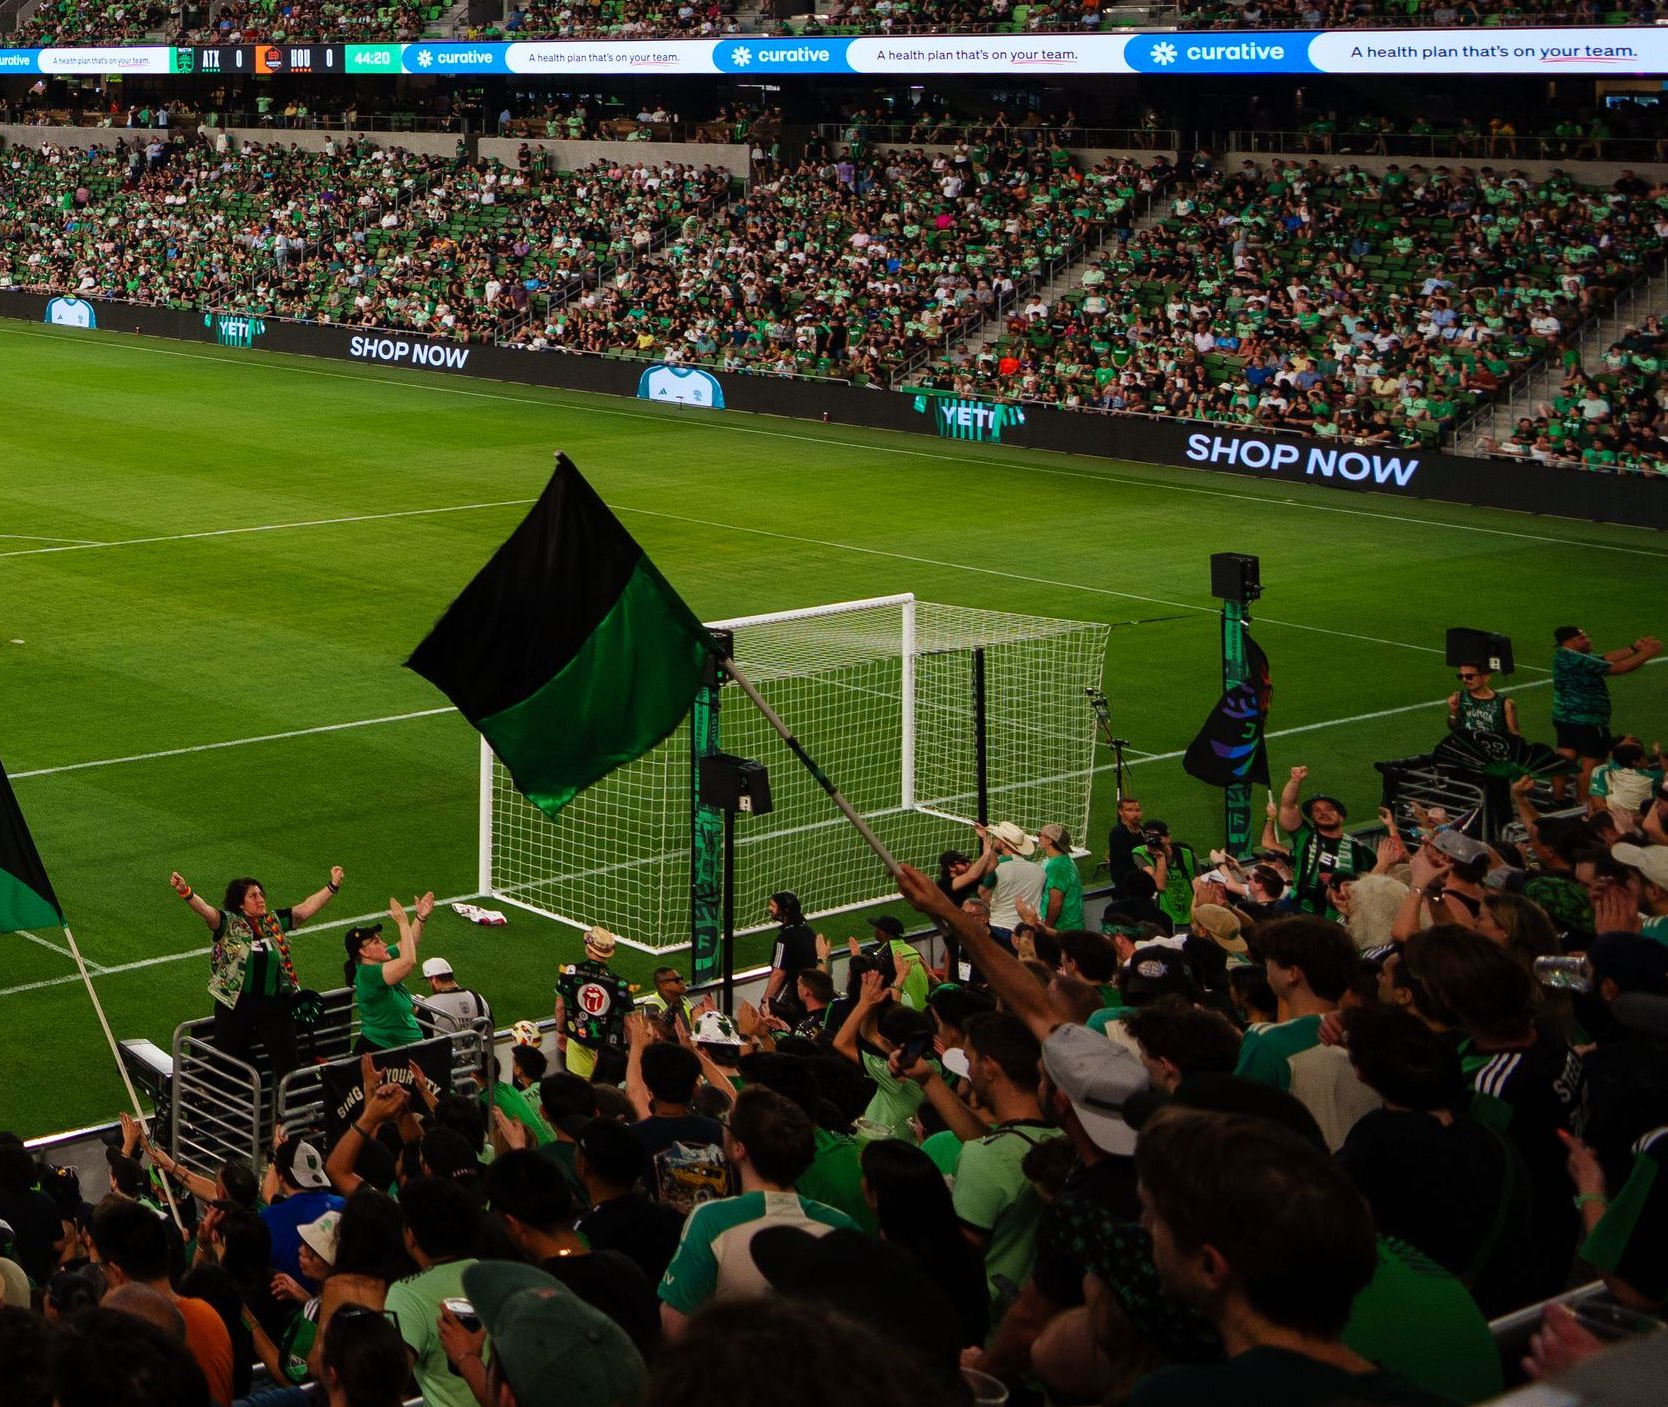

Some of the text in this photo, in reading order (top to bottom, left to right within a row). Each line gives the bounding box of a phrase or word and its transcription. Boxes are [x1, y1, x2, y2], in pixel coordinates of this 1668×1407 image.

[202, 49, 243, 67] ATX 0
[290, 49, 332, 67] HOU 0
[354, 51, 391, 65] 44:20
[437, 50, 493, 64] curative
[529, 52, 680, 65] A health plan that's on your team.
[758, 46, 830, 63] curative
[877, 49, 1078, 63] A health plan that's on your team.
[1186, 41, 1285, 61] curative
[1351, 44, 1638, 60] A health plan that's on your team.
[53, 57, 150, 66] A health plan that's on your team.
[220, 321, 250, 337] YETI
[349, 335, 470, 369] SHOP NOW
[941, 405, 995, 429] YETI
[1185, 433, 1421, 487] SHOP NOW
[336, 1086, 364, 1119] SING
[385, 1066, 414, 1086] YOUR
